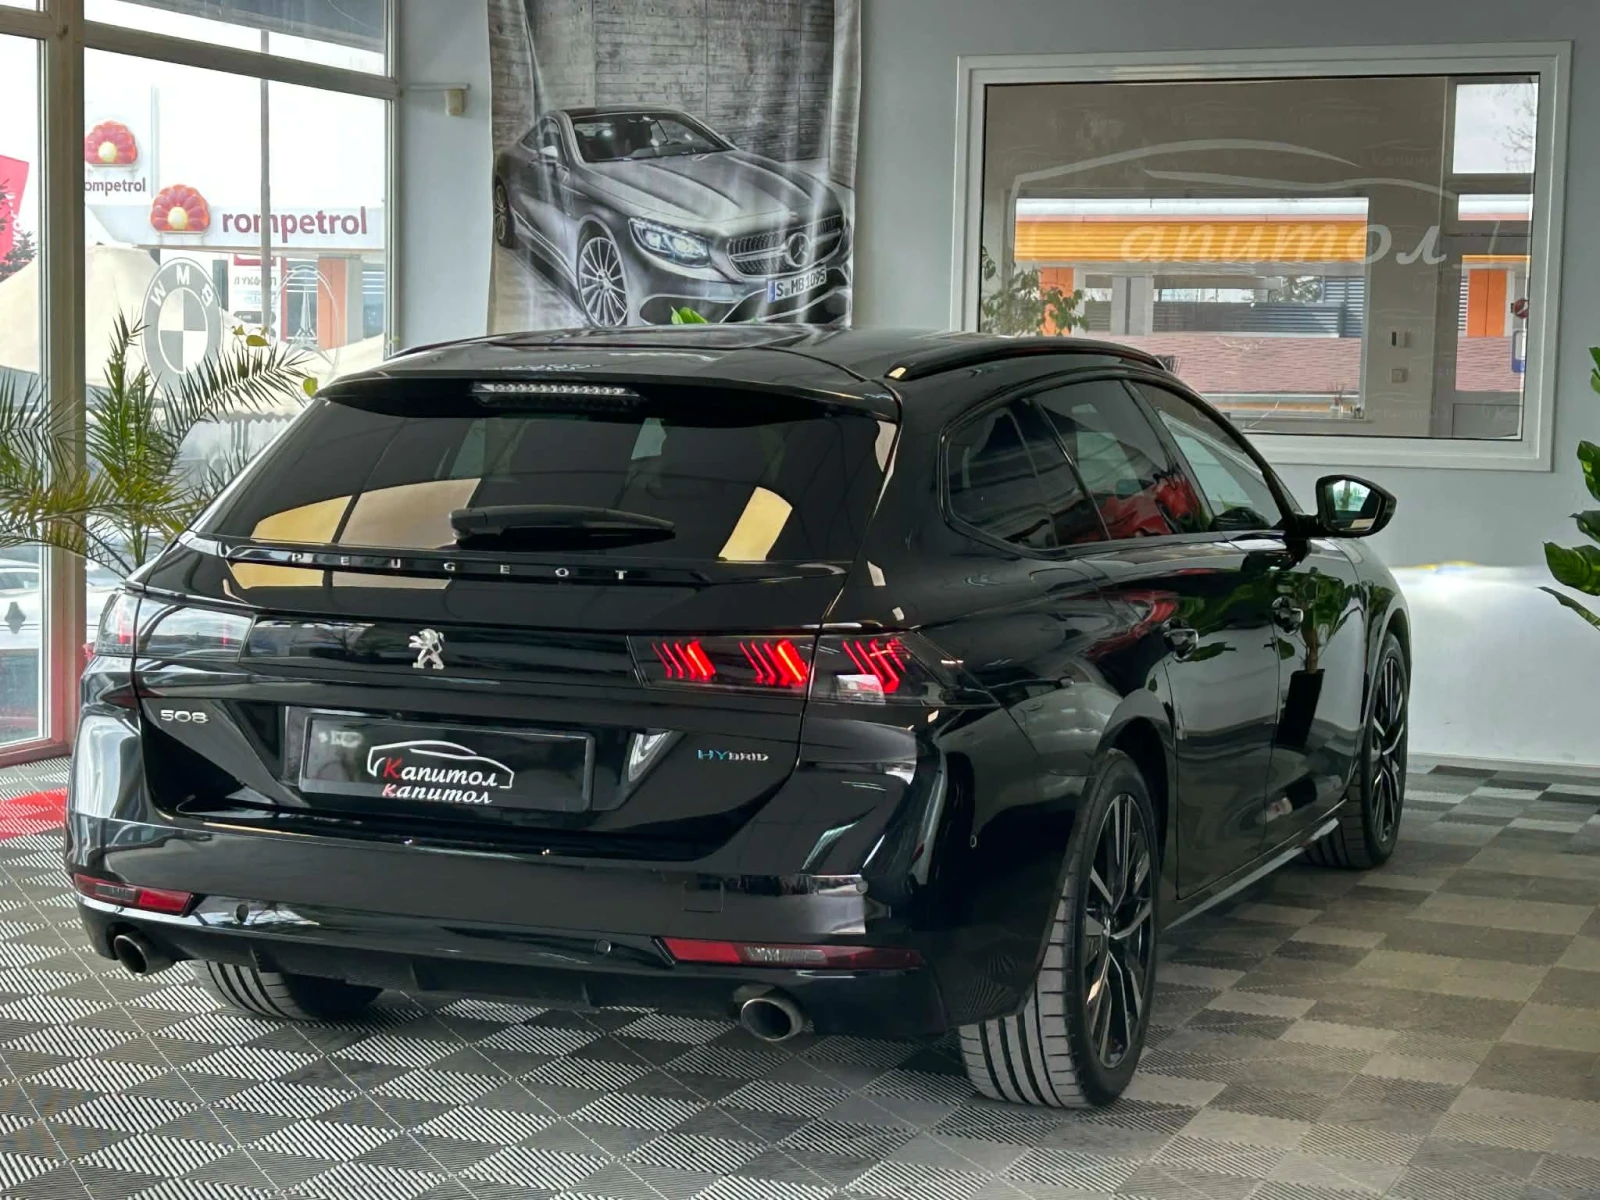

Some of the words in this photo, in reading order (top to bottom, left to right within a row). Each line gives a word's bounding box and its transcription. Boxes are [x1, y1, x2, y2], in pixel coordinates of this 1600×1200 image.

[85, 178, 146, 195] ompetrol
[222, 206, 368, 243] rompetrol
[291, 552, 628, 580] PEUGEOT
[160, 709, 208, 724] 508
[382, 757, 498, 787] Капитол
